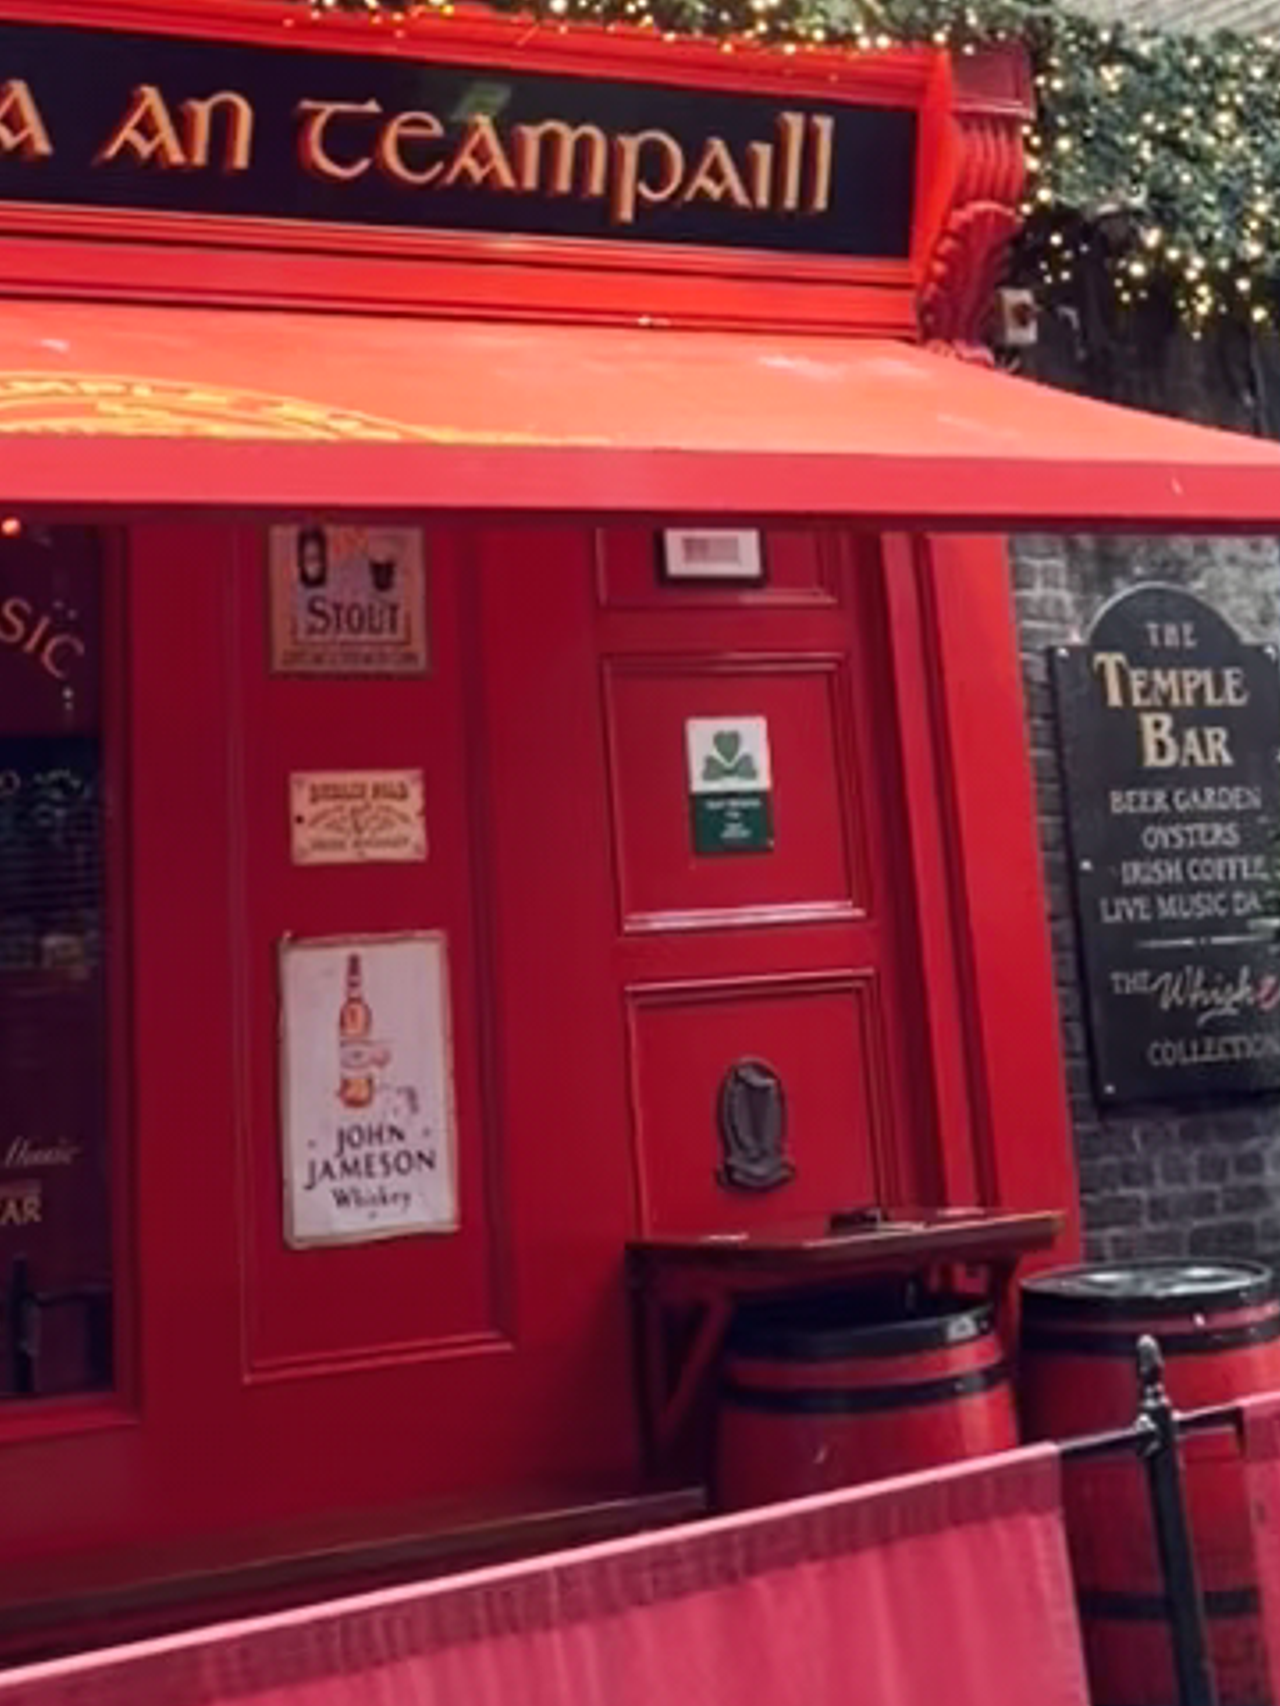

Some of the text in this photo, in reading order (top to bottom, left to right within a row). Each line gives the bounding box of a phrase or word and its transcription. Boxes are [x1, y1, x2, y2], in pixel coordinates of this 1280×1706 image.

[1145, 622, 1198, 648] THE
[1093, 652, 1250, 707] TEMPLE
[1138, 712, 1234, 768] BAR
[1111, 784, 1262, 813] BEER GARDEN
[1142, 821, 1239, 851] OYSTERS
[1121, 858, 1183, 885] IRISH
[1100, 897, 1152, 923] LIVE
[1156, 891, 1228, 918] MUSIC
[334, 1123, 406, 1158] JOHN
[302, 1149, 437, 1190] JAMESON
[330, 1189, 413, 1210] Whiskey
